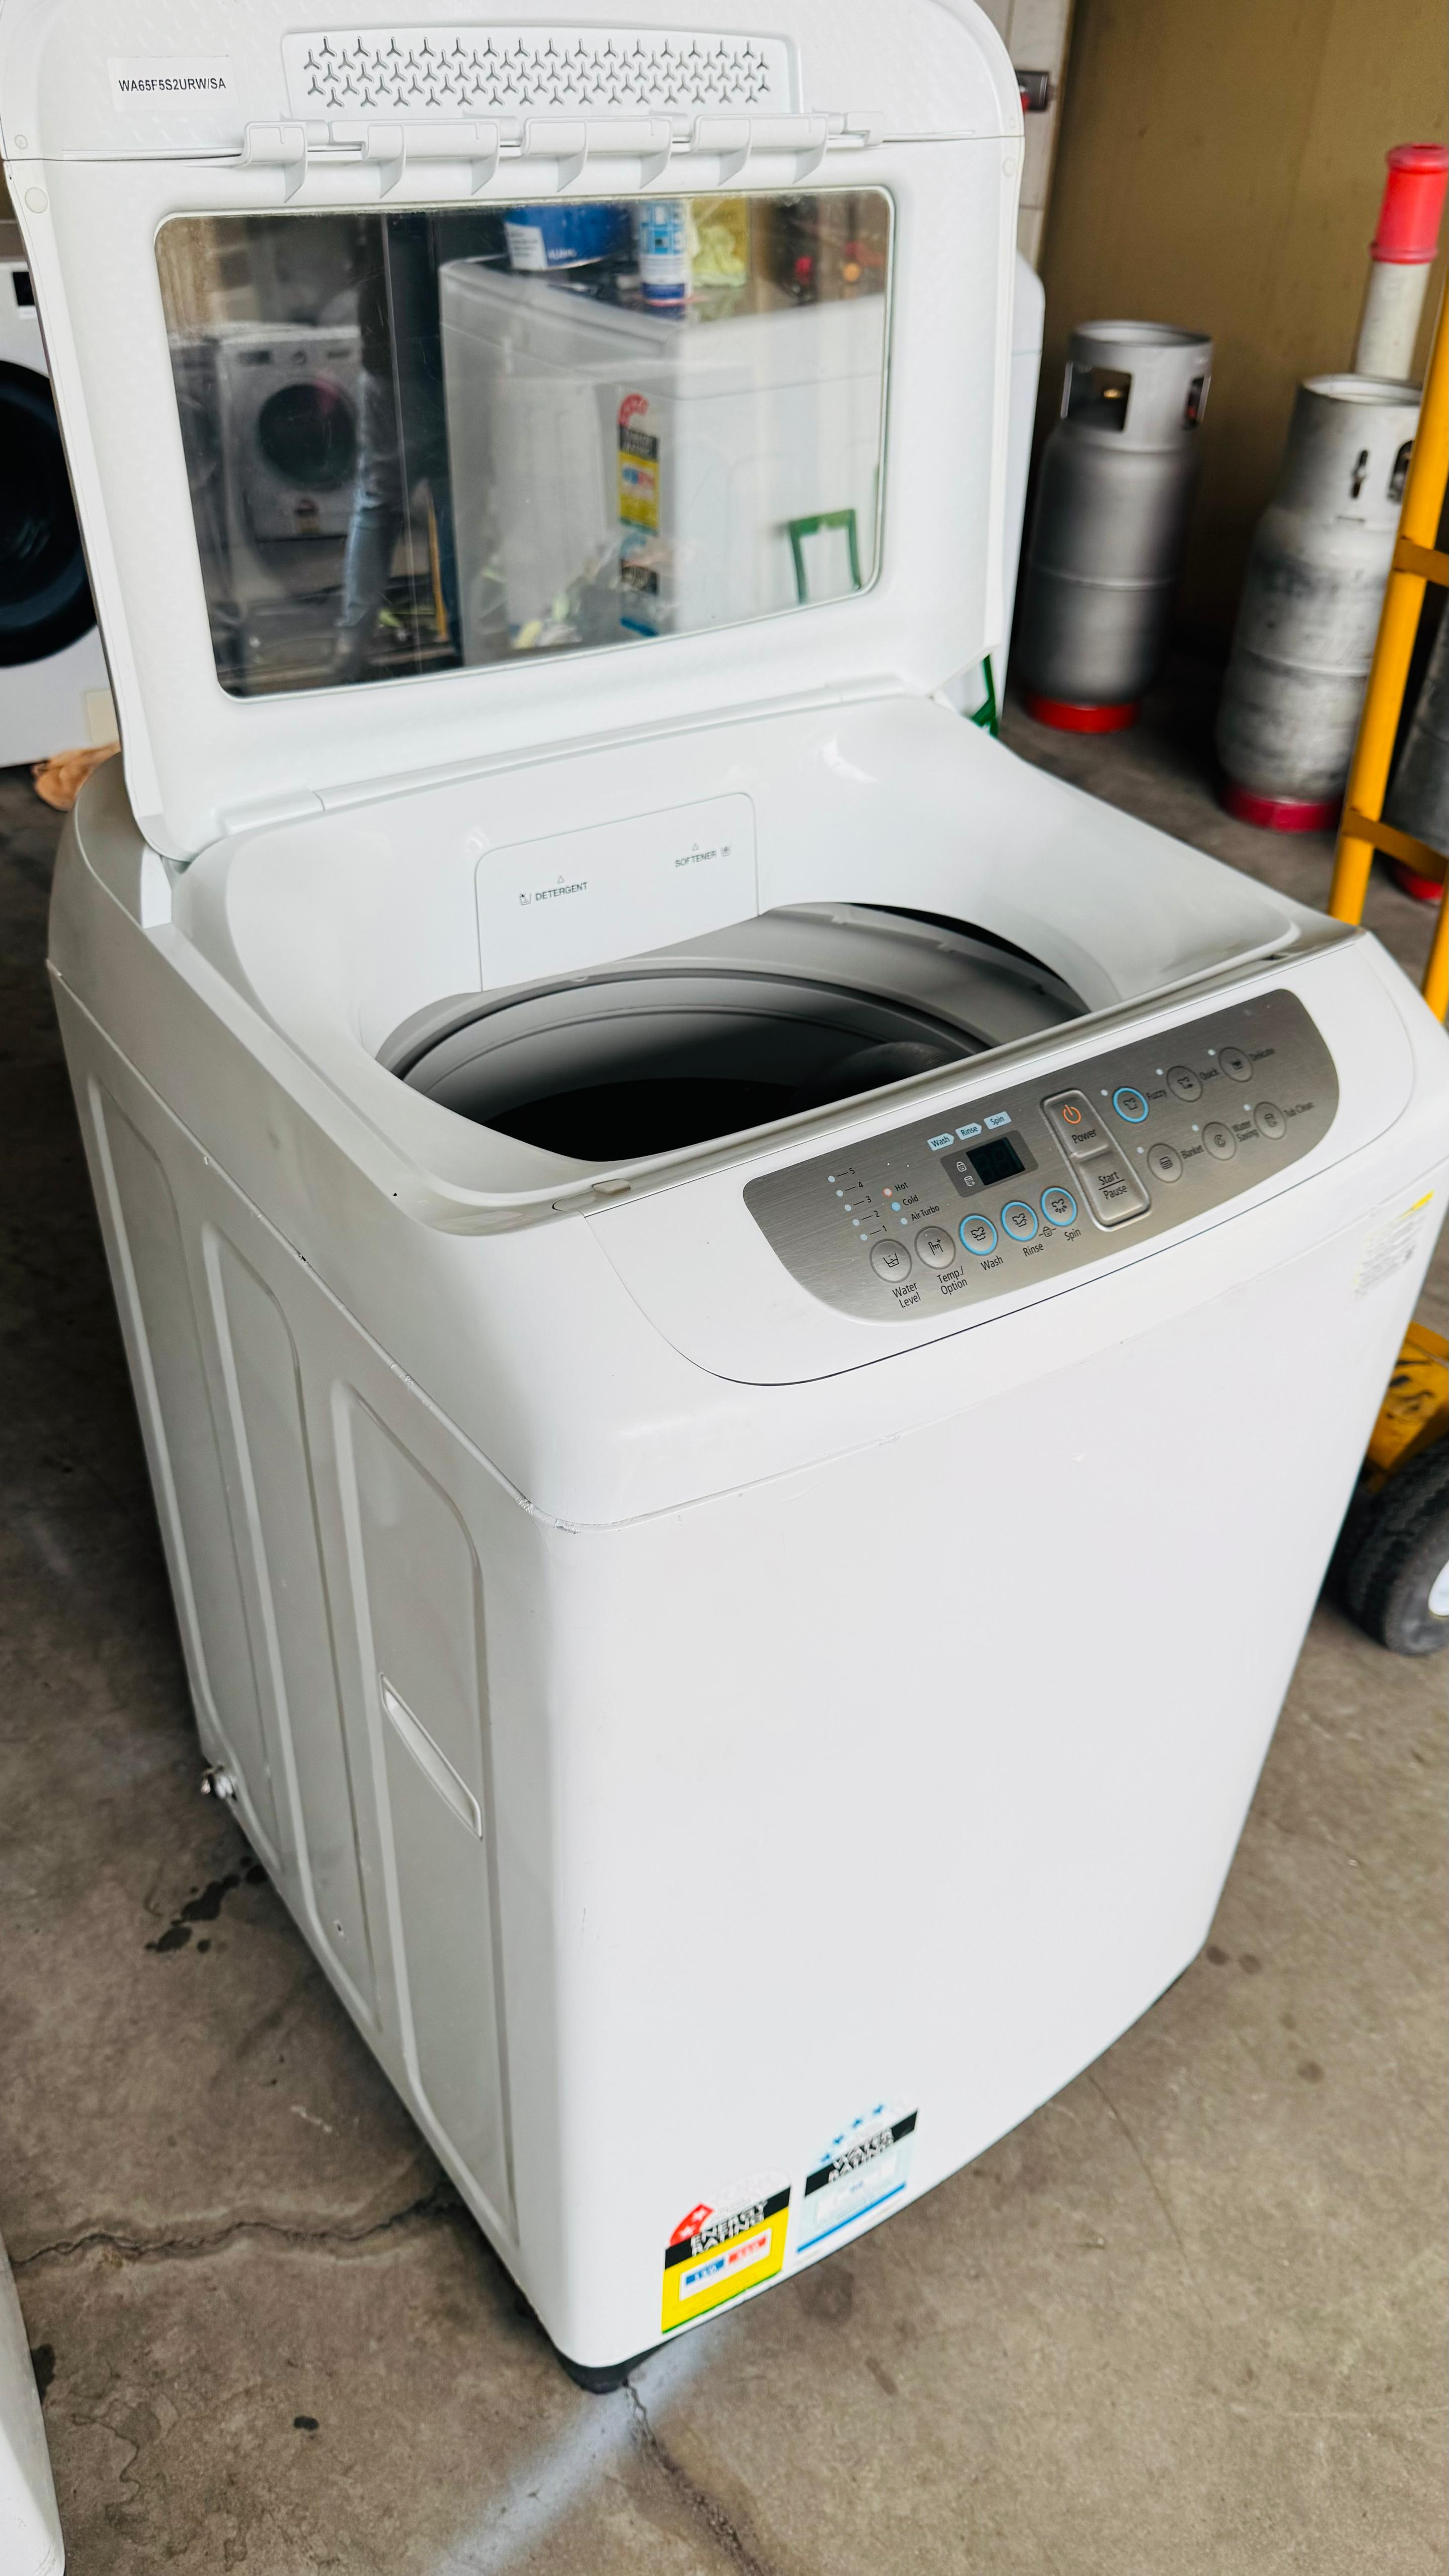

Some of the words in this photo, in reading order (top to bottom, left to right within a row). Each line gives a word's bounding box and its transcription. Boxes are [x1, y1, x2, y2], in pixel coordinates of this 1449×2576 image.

[119, 77, 226, 92] WA65F5S2URW/SA
[675, 850, 716, 867] SOFTENER
[535, 881, 588, 902] DETERGENT
[1146, 1089, 1167, 1101] Fuzzy
[931, 1135, 950, 1147] Wash
[960, 1126, 979, 1137] Rinse
[990, 1116, 1005, 1125] Spin
[1232, 1120, 1251, 1132] Water
[1071, 1129, 1097, 1144] Power
[1236, 1129, 1259, 1143] Saving
[1180, 1145, 1204, 1159] Blanket
[1098, 1172, 1119, 1185] Start
[895, 1182, 908, 1191] Hot
[1103, 1185, 1128, 1200] Pause
[903, 1194, 919, 1206] Cold
[1064, 1229, 1081, 1242] Spin
[1023, 1243, 1044, 1257] Rinse
[981, 1255, 1004, 1271] Wash
[937, 1266, 964, 1283] Temp./
[892, 1282, 918, 1298] Water
[941, 1278, 968, 1296] Option
[899, 1292, 921, 1308] Level
